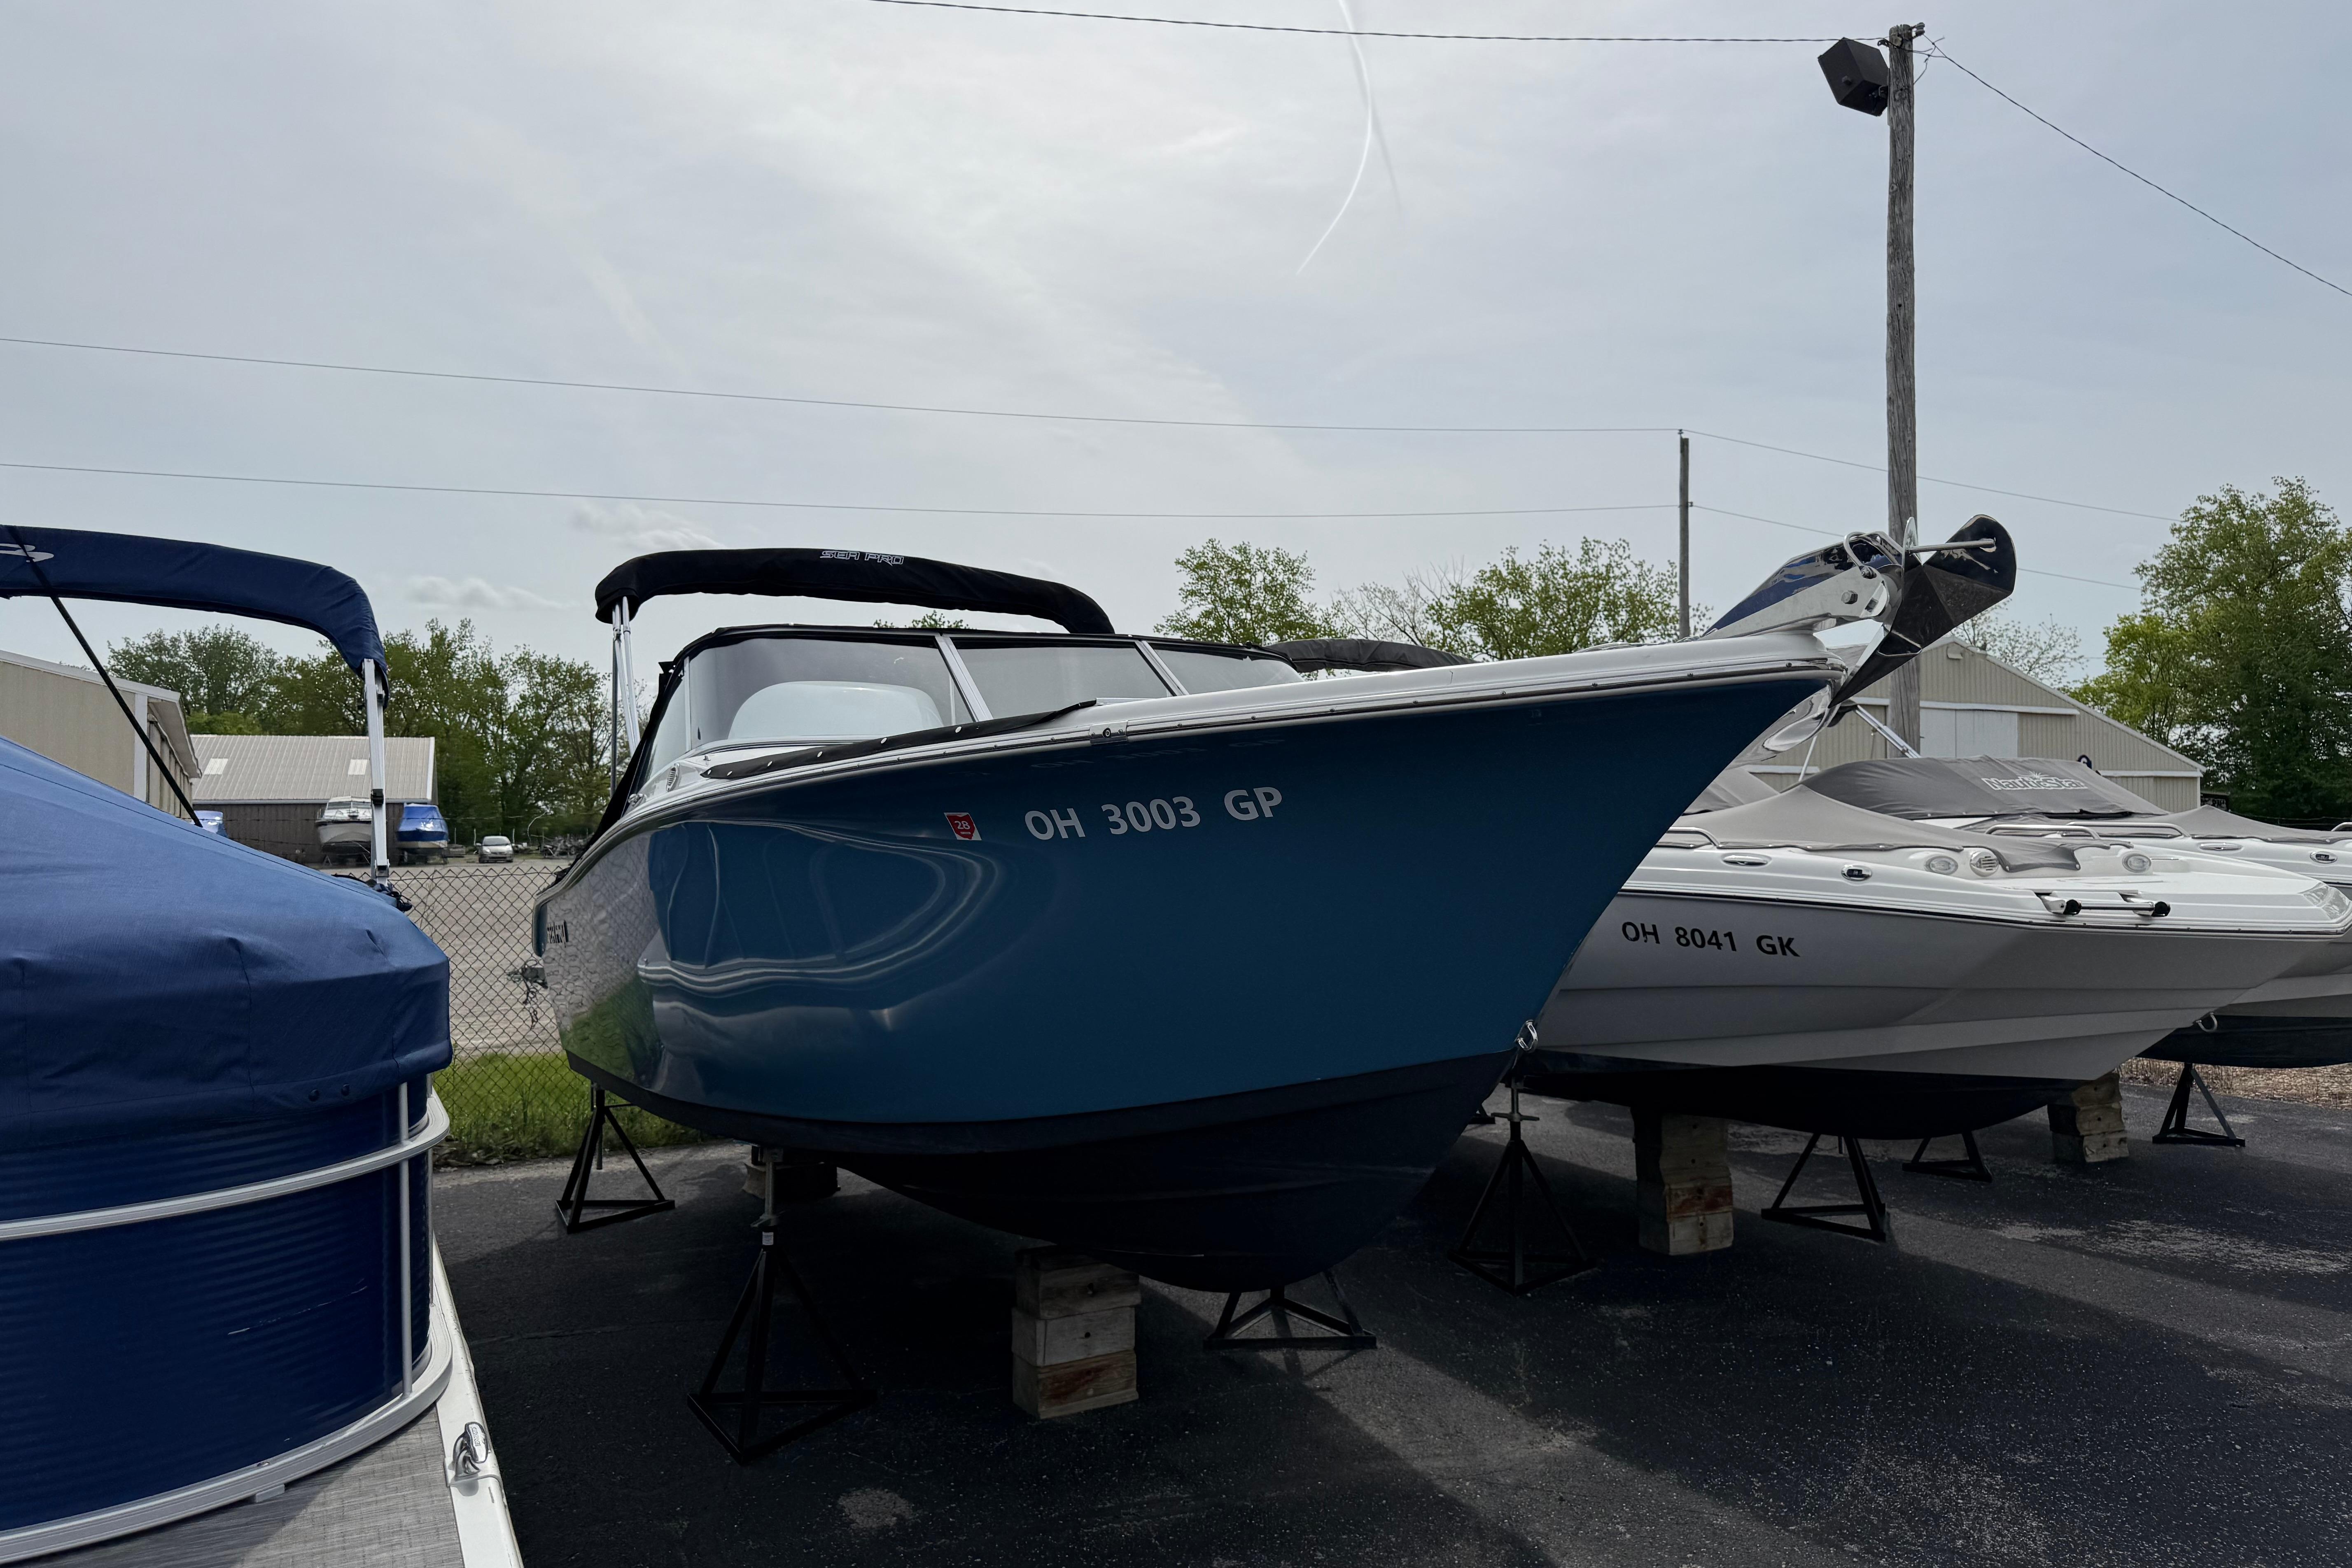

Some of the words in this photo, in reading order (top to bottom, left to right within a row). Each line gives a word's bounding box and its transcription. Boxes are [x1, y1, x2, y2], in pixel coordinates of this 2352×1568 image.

[820, 551, 860, 560] SEA
[864, 552, 904, 566] PRO
[1981, 776, 2088, 790] NauticStar
[1025, 808, 1085, 840] OH
[1101, 796, 1200, 835] 3003
[1224, 787, 1282, 821] GP
[954, 821, 970, 830] 28
[1622, 922, 1660, 944] OH
[1675, 926, 1737, 952] 8041
[1756, 935, 1801, 957] GK
